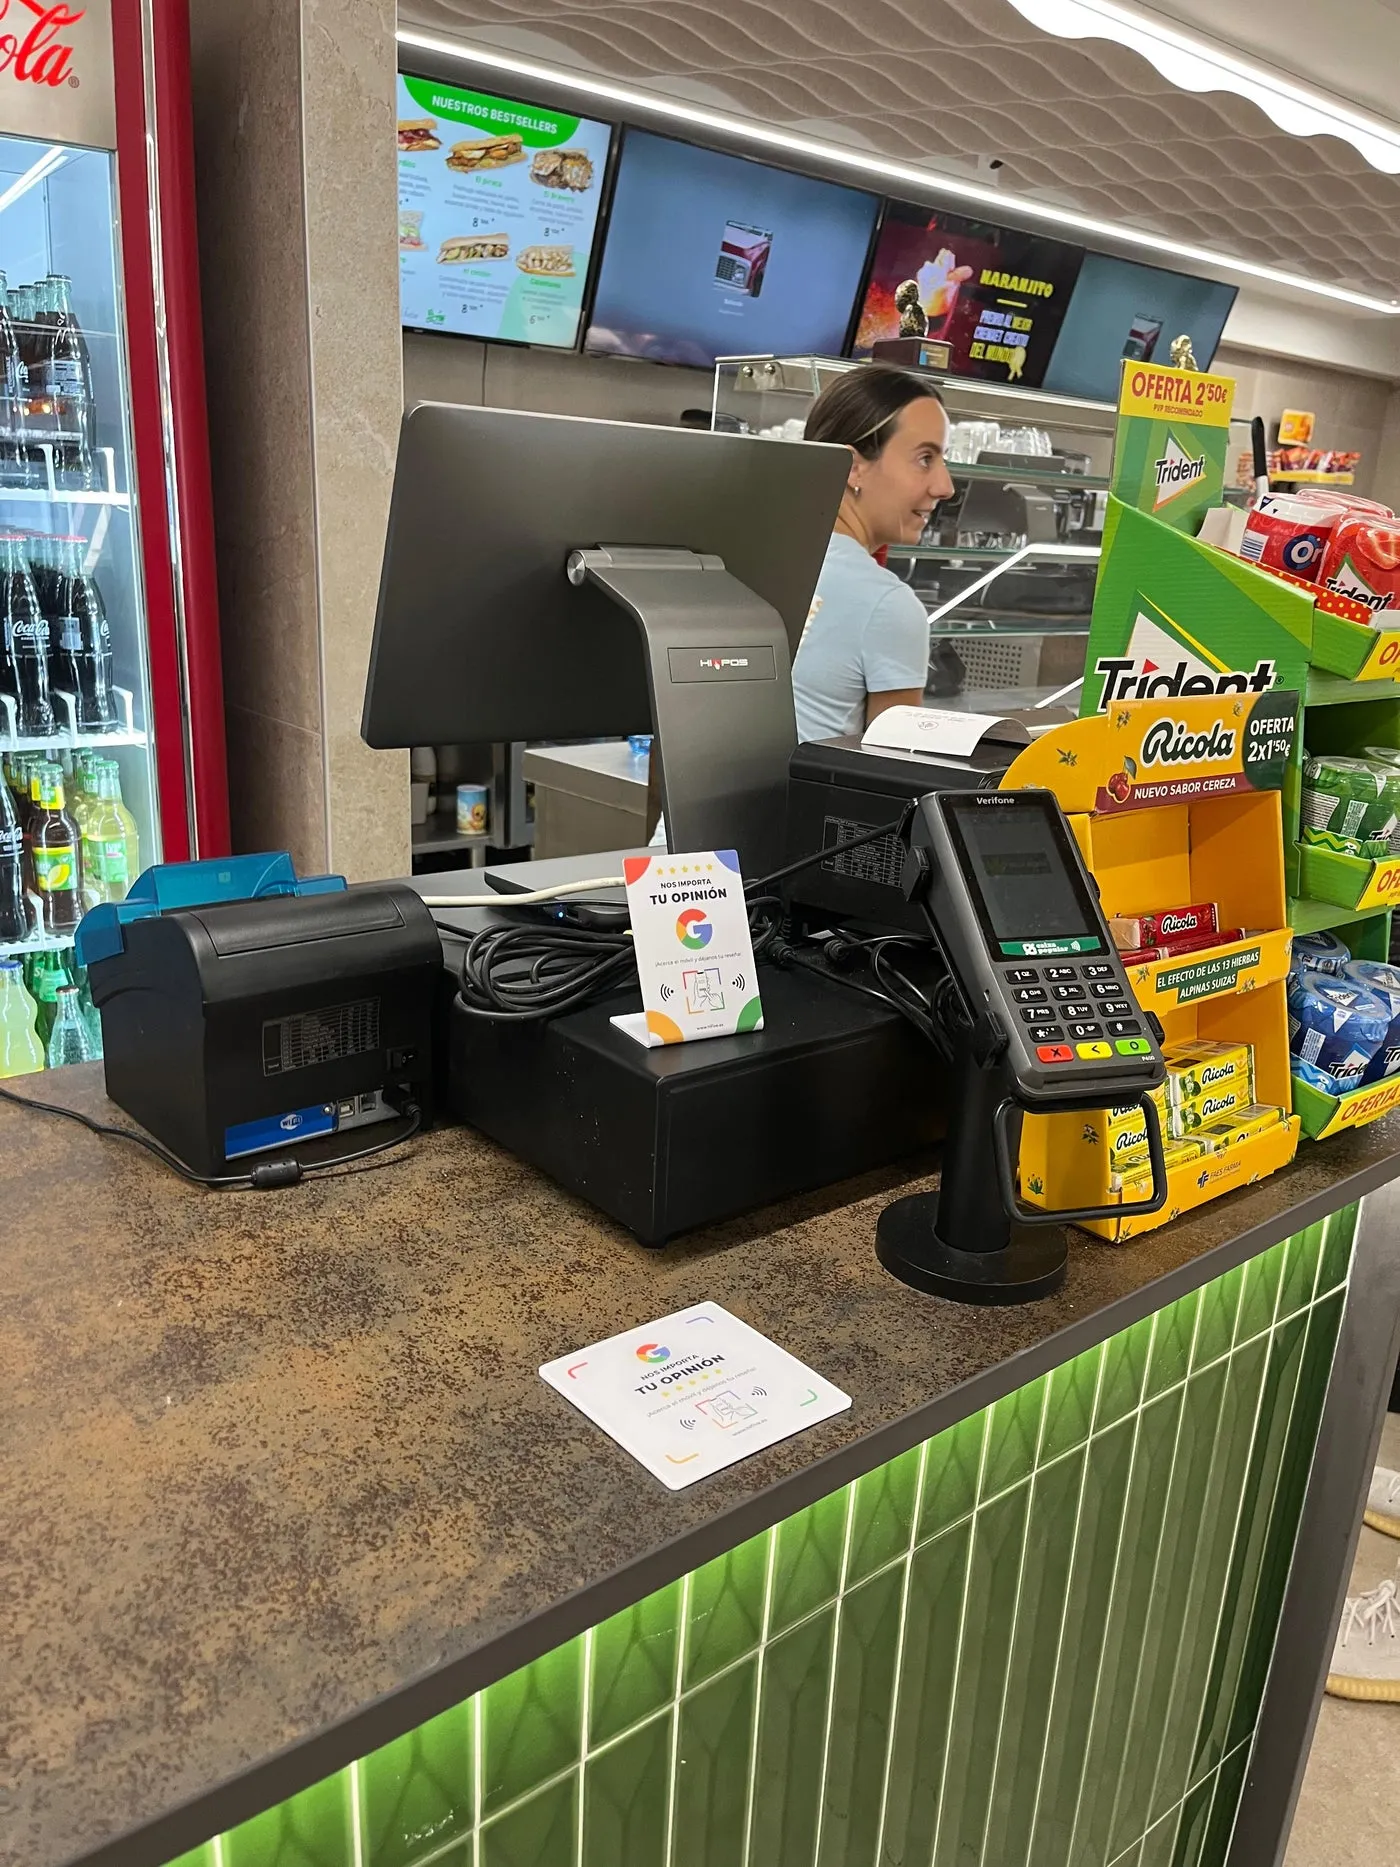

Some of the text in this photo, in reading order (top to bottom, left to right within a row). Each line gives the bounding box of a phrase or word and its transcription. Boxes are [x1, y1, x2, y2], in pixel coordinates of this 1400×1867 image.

[431, 95, 558, 134] NUESTROS BESTSELLERS
[980, 269, 1054, 298] NARANJITO
[1132, 371, 1192, 404] OFERTA
[1155, 455, 1205, 484] Trident
[1097, 660, 1272, 709] Trident
[1250, 716, 1294, 736] OFERTA
[1142, 719, 1235, 765] Ricola
[1134, 777, 1236, 799] NUEVO SABOR CEREZA
[976, 797, 1015, 805] Verifone
[660, 878, 712, 889] NOS IMPORTA
[649, 886, 727, 905] TU OPINIÓN
[1162, 915, 1197, 933] Ricola
[1014, 970, 1021, 980] 1
[1049, 968, 1059, 978] 2
[1088, 966, 1097, 976] 3
[1157, 951, 1259, 988] EL EFECTO DE LAS 13 HIERBAS
[1020, 990, 1029, 1000] 4
[1058, 987, 1068, 996] 5
[1096, 984, 1105, 994] 6
[1179, 974, 1236, 998] ALPINAS SUIZAS
[1027, 1009, 1035, 1019] 7
[1067, 1006, 1077, 1016] 8
[1105, 1003, 1114, 1013] 9
[1075, 1025, 1085, 1035] 0
[1201, 1062, 1234, 1085] Ricola
[1329, 1062, 1368, 1079] Tride
[1202, 1094, 1235, 1116] Ricola
[1341, 1083, 1400, 1121] OFERTA
[1116, 1127, 1148, 1151] Ricol
[634, 1354, 726, 1395] TU OPINIÓN
[641, 1354, 700, 1381] NOS IMPORTA
